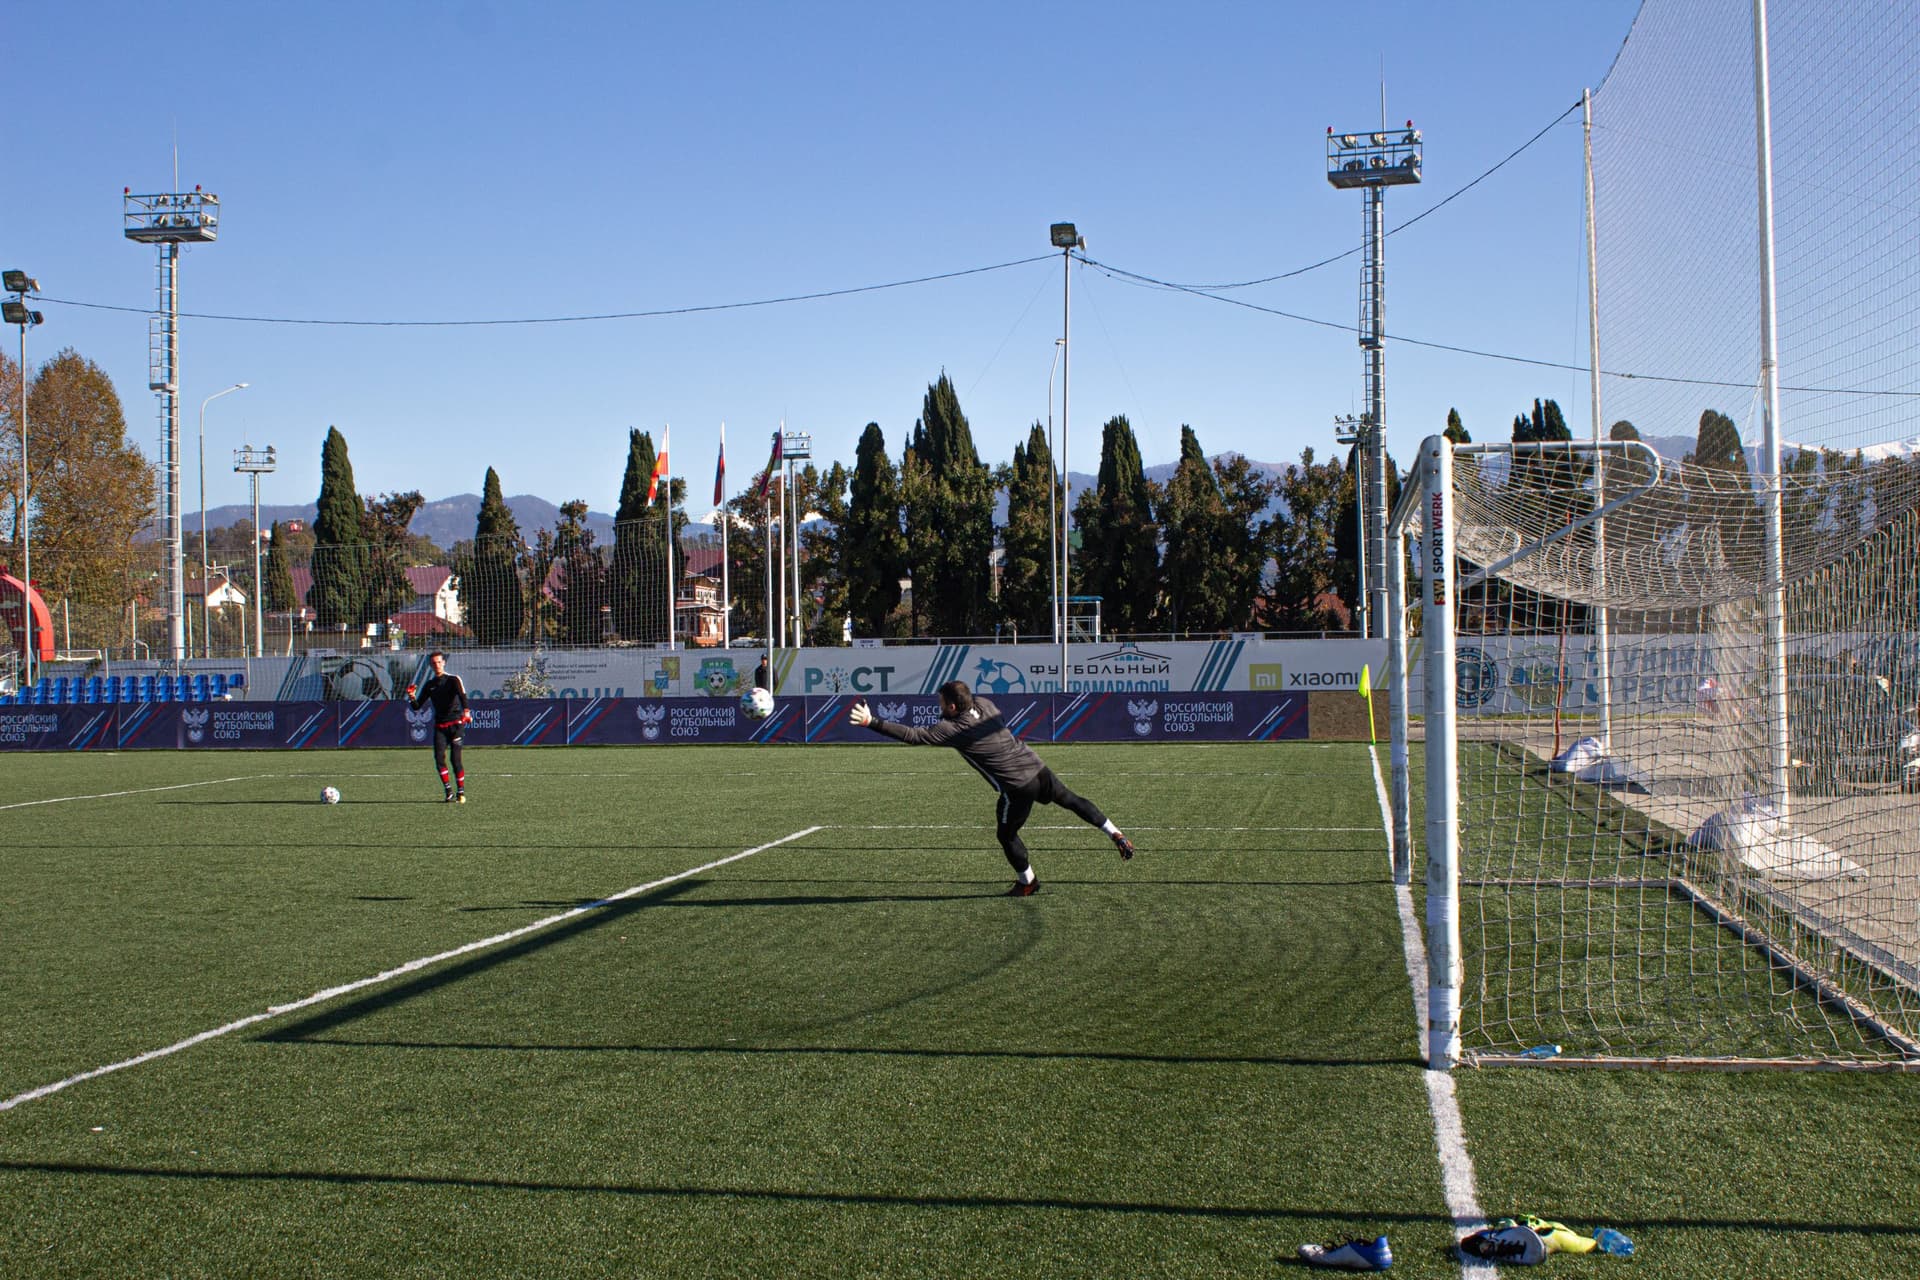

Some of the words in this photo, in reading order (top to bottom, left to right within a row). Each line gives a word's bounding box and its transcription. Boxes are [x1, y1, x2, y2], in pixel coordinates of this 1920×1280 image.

[1432, 492, 1444, 573] SPORTWERK
[670, 706, 736, 717] РОССИЙСКИЙ
[1164, 701, 1234, 713] РОССИЙСКИЙ
[0, 713, 58, 724] РОССИЙСКИЙ
[213, 710, 274, 721] РОССИЙСКИЙ
[1164, 711, 1234, 722] ФУТБОЛЬНЫЙ
[213, 720, 274, 730] ФУТБОЛЬНЫЙ
[670, 716, 736, 727] ФУТБОЛЬНЫЙ
[0, 723, 58, 733] ФУТБОЛЬНЫЙ
[670, 727, 700, 737] СОЮЗ
[1164, 722, 1195, 733] СОЮЗ
[0, 733, 26, 742] СОЮЗ
[213, 729, 241, 739] СОЮЗ
